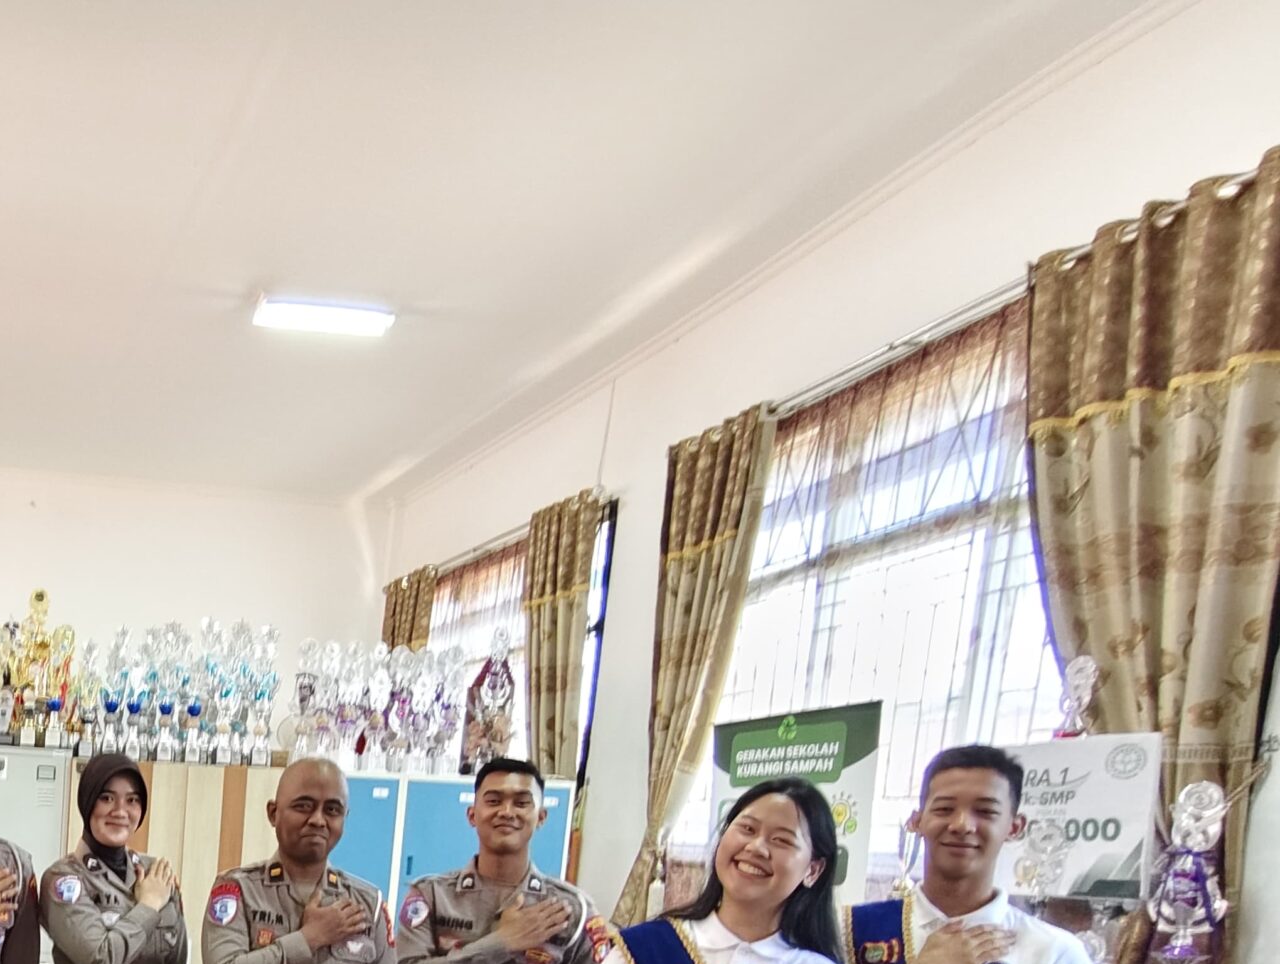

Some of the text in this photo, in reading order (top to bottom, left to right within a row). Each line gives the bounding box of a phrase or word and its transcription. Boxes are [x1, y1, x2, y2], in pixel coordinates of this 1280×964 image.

[736, 741, 840, 764] GERAKAN SEKOLAH
[736, 758, 835, 779] KURANGI SAMPAH
[1059, 766, 1070, 787] 1
[1039, 789, 1076, 806] SMP
